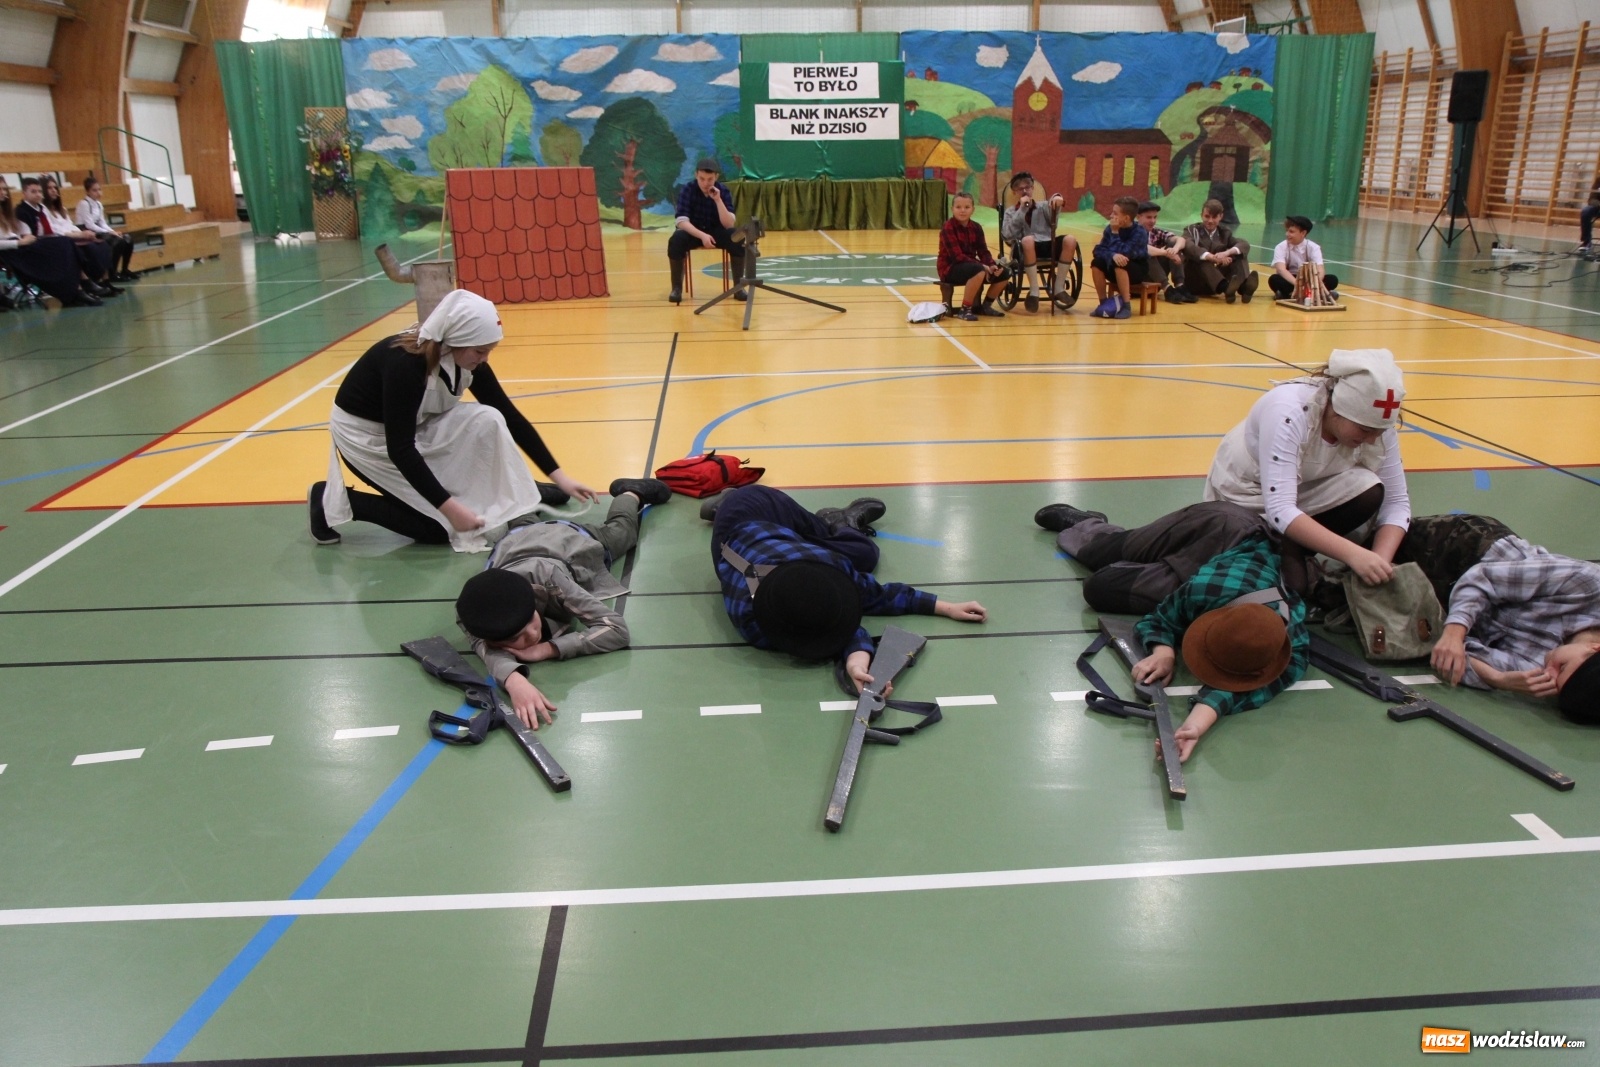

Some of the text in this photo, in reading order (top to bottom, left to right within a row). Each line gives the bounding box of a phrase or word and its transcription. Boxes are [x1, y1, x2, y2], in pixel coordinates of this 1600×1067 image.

[793, 66, 858, 78] PIERWEJ
[794, 80, 858, 93] TO BYŁO
[769, 107, 889, 120] BLANK INAKSZY
[791, 121, 867, 135] NIŻ DZISIO
